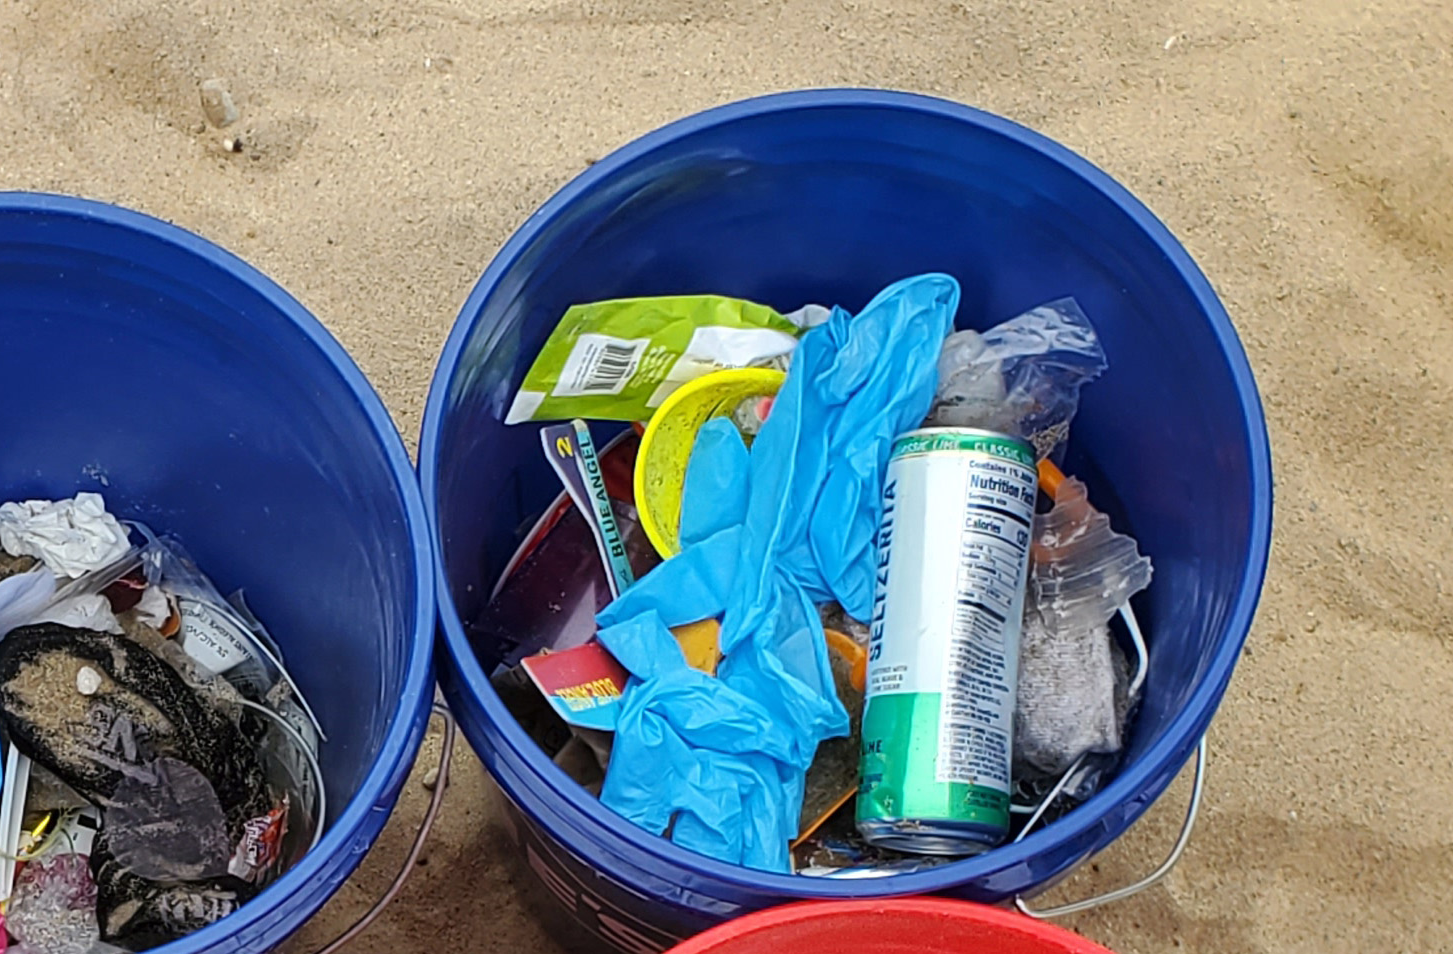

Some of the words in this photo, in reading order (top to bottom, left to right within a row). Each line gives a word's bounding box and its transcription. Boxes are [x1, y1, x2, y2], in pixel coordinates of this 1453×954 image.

[556, 436, 574, 459] 2
[579, 436, 610, 504] ANGEL
[969, 474, 1019, 499] Nutrition
[599, 506, 625, 558] BLUE
[965, 517, 1002, 535] Calories
[867, 479, 898, 662] SELTZERITA
